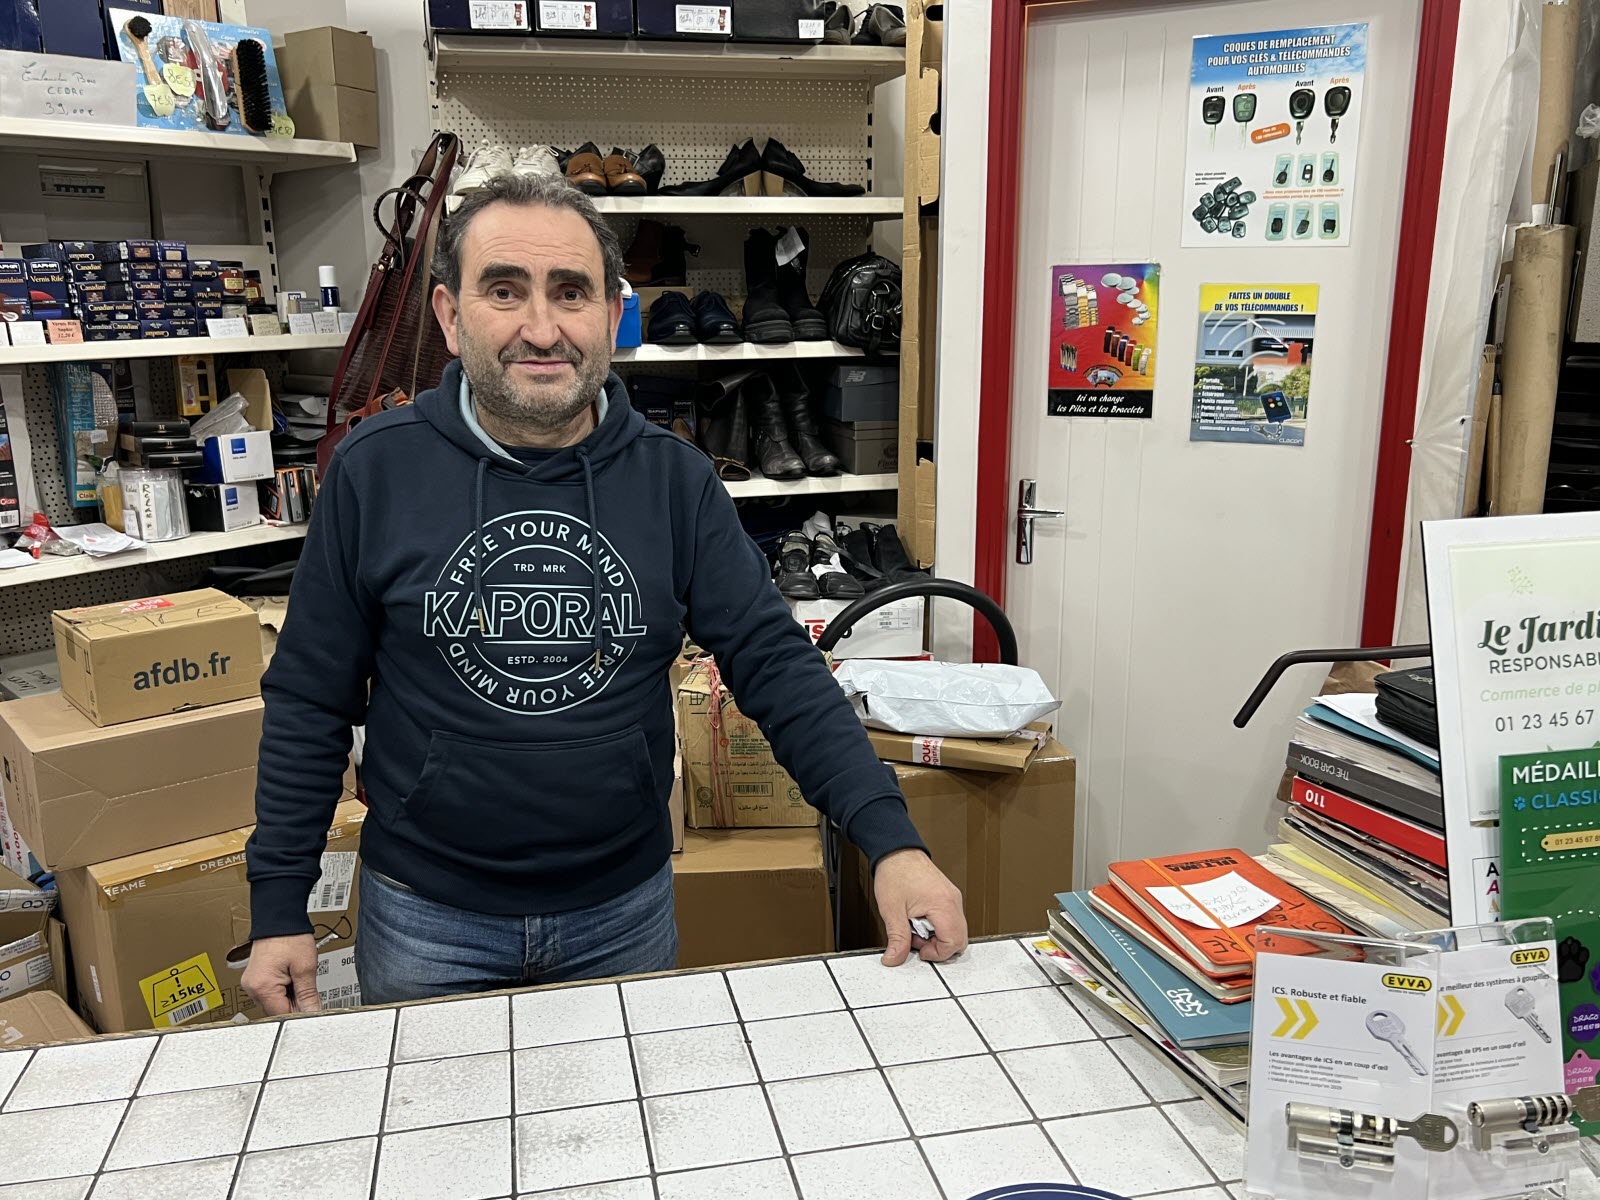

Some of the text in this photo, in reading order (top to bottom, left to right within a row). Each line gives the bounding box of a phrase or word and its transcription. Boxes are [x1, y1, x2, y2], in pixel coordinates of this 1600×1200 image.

[1224, 34, 1336, 52] COQUES DE REMPLACEMENT
[1208, 46, 1351, 66] POUR VOS CLÉS & TÉLÉCOMMANDES
[1247, 62, 1306, 76] AUTOMOBILES
[1237, 83, 1256, 91] Après
[1330, 77, 1350, 85] Après
[1229, 292, 1290, 300] FAITES UN DOUBLE
[1241, 303, 1298, 311] TÉLÉCOMMANDES
[1076, 394, 1087, 402] Ici
[1100, 394, 1124, 404] change
[1098, 405, 1108, 413] les
[1111, 405, 1144, 413] Bracelets
[502, 520, 571, 542] YOUR
[514, 563, 567, 573] TRD MRK
[423, 591, 647, 638] KAPORAL
[1477, 619, 1511, 656] Le
[507, 655, 568, 665] ESTD. 2004
[134, 652, 230, 690] afdb.fr
[449, 642, 624, 706] FREE YOUR MIND
[1480, 682, 1584, 702] Commerce de
[1495, 709, 1594, 732] 01 23 45 67
[1300, 754, 1320, 770] BOOK
[1320, 762, 1336, 775] CAR
[1336, 771, 1350, 781] THE
[1305, 789, 1325, 808] 110
[200, 853, 246, 873] DREAME
[102, 878, 146, 897] REAME
[1110, 928, 1136, 955] AGENDA
[1515, 952, 1545, 962] EVVA
[1388, 976, 1426, 989] EVVA
[1446, 982, 1472, 991] meilleur
[1486, 977, 1515, 988] systèmes
[1272, 986, 1367, 1004] ICS. Robuste et fiable
[1573, 1014, 1599, 1023] DRAGO
[1281, 1053, 1312, 1062] avantages
[1436, 1050, 1463, 1058] avantages
[1567, 1067, 1592, 1076] DRAGO
